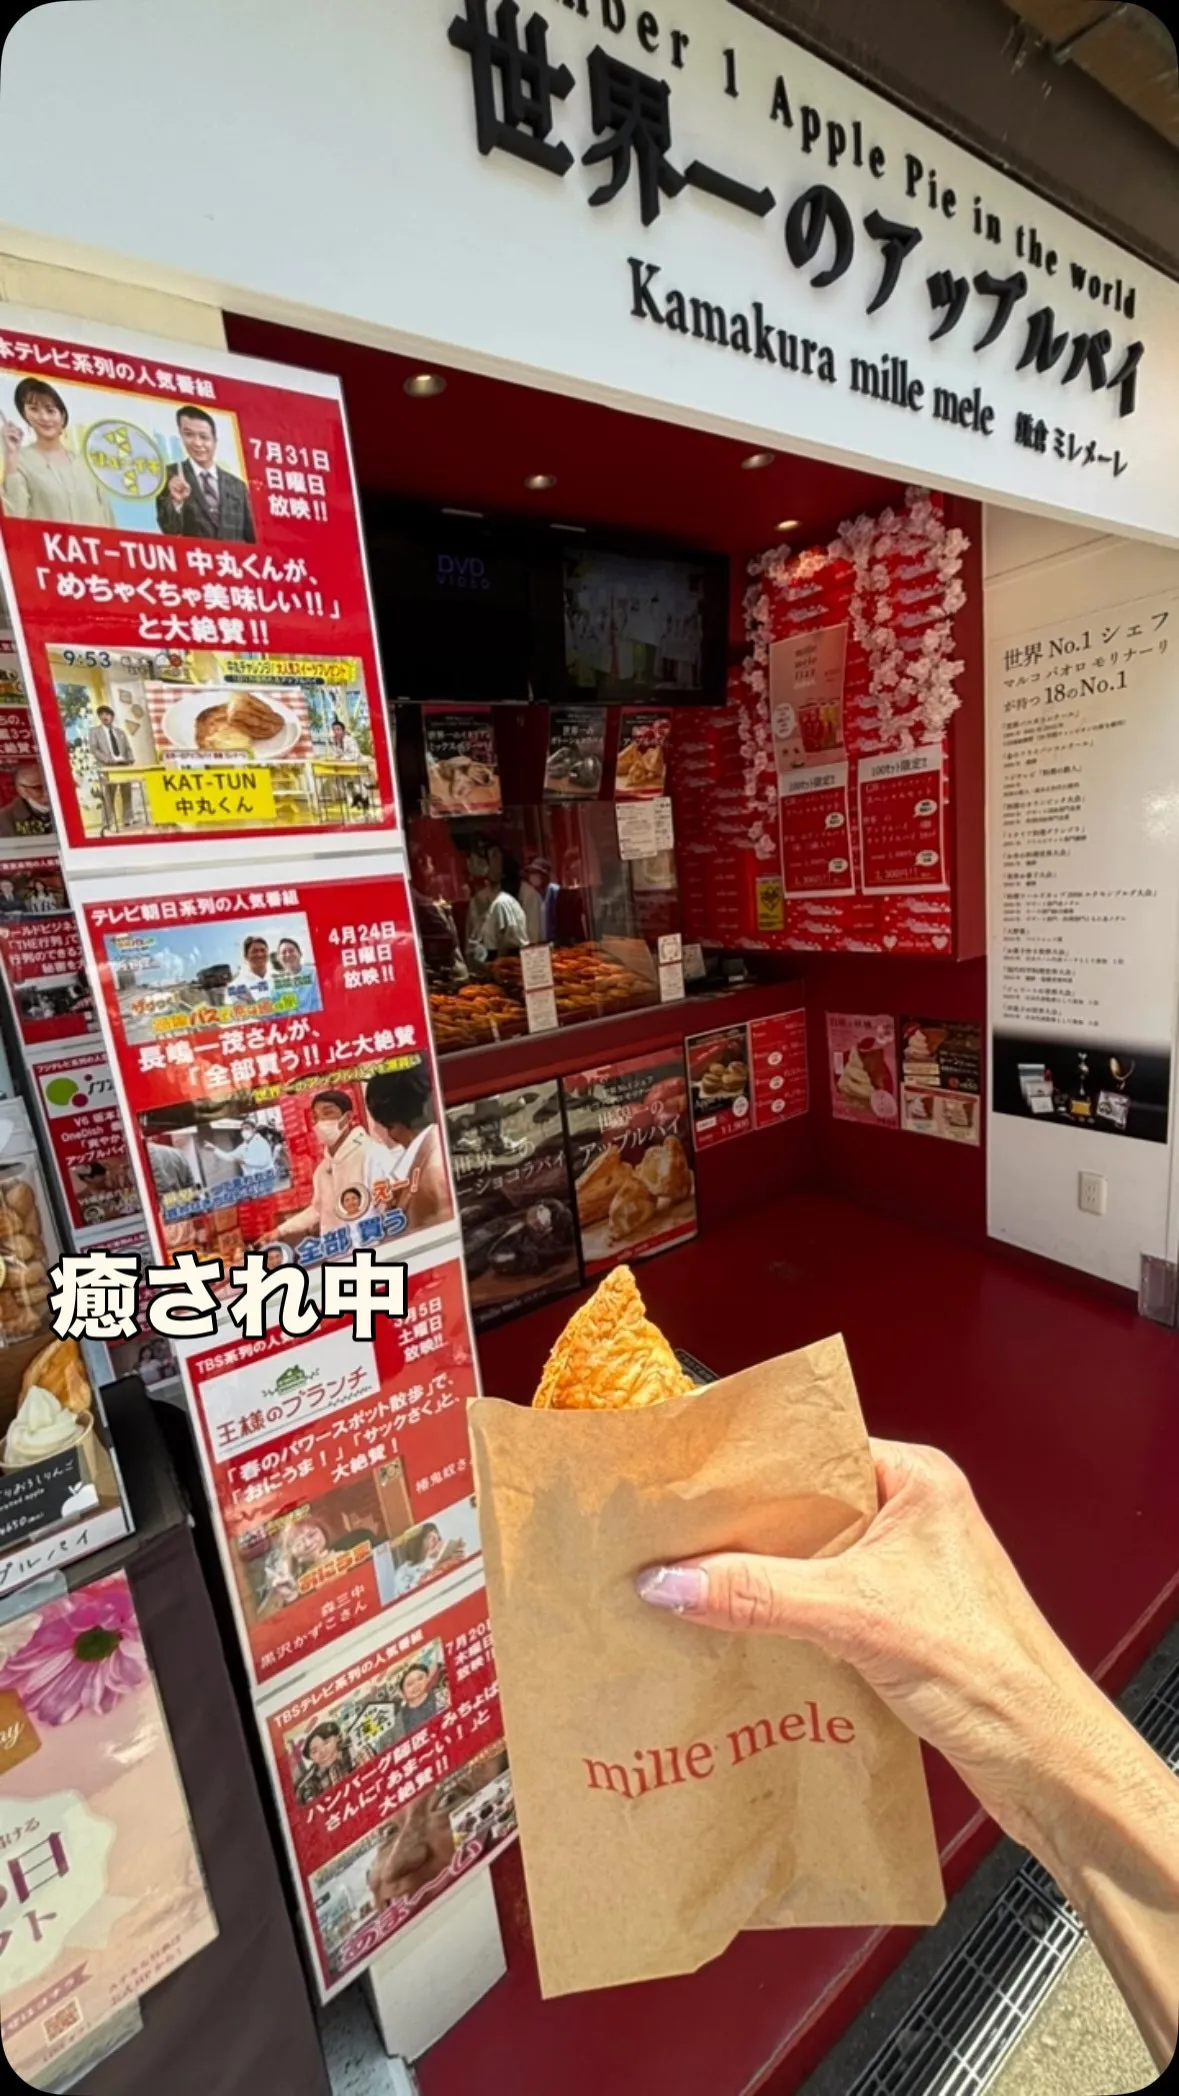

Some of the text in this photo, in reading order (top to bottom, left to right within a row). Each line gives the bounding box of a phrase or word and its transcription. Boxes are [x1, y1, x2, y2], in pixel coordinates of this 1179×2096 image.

[558, 0, 1136, 319] ber 1 Apple Pie in the world
[448, 0, 1145, 418] 世界一のアップルパイ
[627, 256, 995, 437] Kamakura mille mele
[249, 438, 331, 472] 7月31日
[1053, 427, 1129, 478] ミレメーレ
[265, 467, 326, 497] 日曜日
[43, 532, 177, 573] KAT-TUN
[63, 649, 112, 669] 9:53
[1003, 611, 1169, 672] 世界 No.1 シェフ
[163, 773, 257, 792] KAT-TUN
[175, 797, 255, 818] 中丸くん
[91, 889, 300, 927] テレビ朝日系列の人気番組
[328, 920, 398, 946] 4月24日
[10, 947, 83, 966] 行列のできる
[341, 943, 393, 968] 日曜日
[295, 1223, 352, 1267] 全部
[398, 1317, 444, 1347] 土曜日
[216, 1366, 369, 1447] 王様のブランチ
[0, 1459, 74, 1497] りおろしりんご
[415, 1457, 473, 1494] 椿鬼奴さ
[320, 1584, 366, 1617] 森三中
[260, 1602, 368, 1669] 黒沢かずこさん
[274, 1629, 424, 1728] TBSテレビ系列の人気番組
[581, 1740, 716, 1799] mille
[726, 1700, 857, 1767] mele
